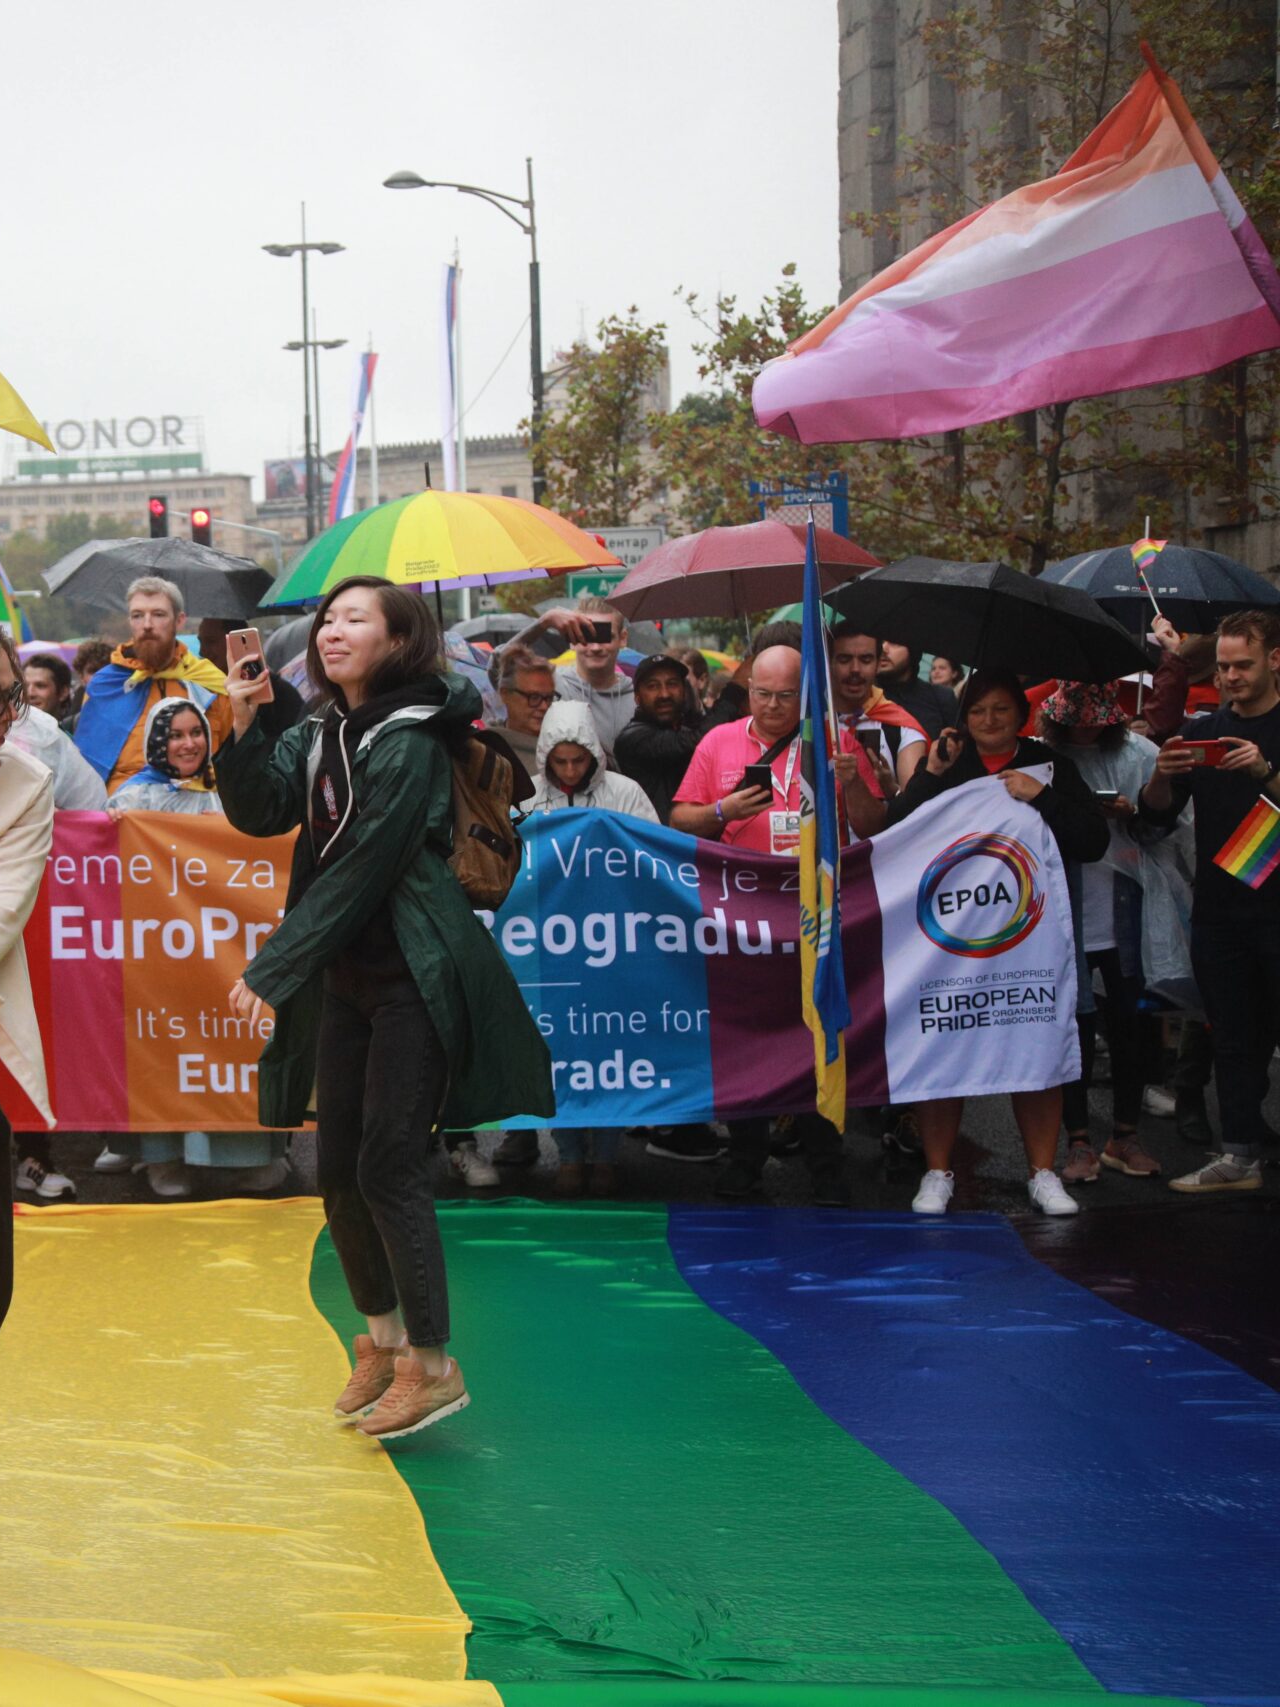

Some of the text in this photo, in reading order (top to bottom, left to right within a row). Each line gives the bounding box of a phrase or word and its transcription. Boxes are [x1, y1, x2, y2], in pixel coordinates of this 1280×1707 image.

[609, 538, 649, 549] ентар
[47, 844, 275, 897] eme je za
[550, 835, 701, 888] Vreme
[718, 860, 759, 901] je
[780, 870, 800, 892] z
[937, 881, 1013, 916] EPOA
[50, 905, 284, 960] EuroPr
[920, 968, 1055, 991] LICENSOR OF EUROPRIDE
[919, 985, 1057, 1015] EUROPEAN
[136, 1007, 275, 1040] It's time
[567, 1003, 647, 1035] time
[661, 1001, 711, 1033] for
[920, 1011, 991, 1034] PRIDE
[551, 1049, 671, 1091] rade.
